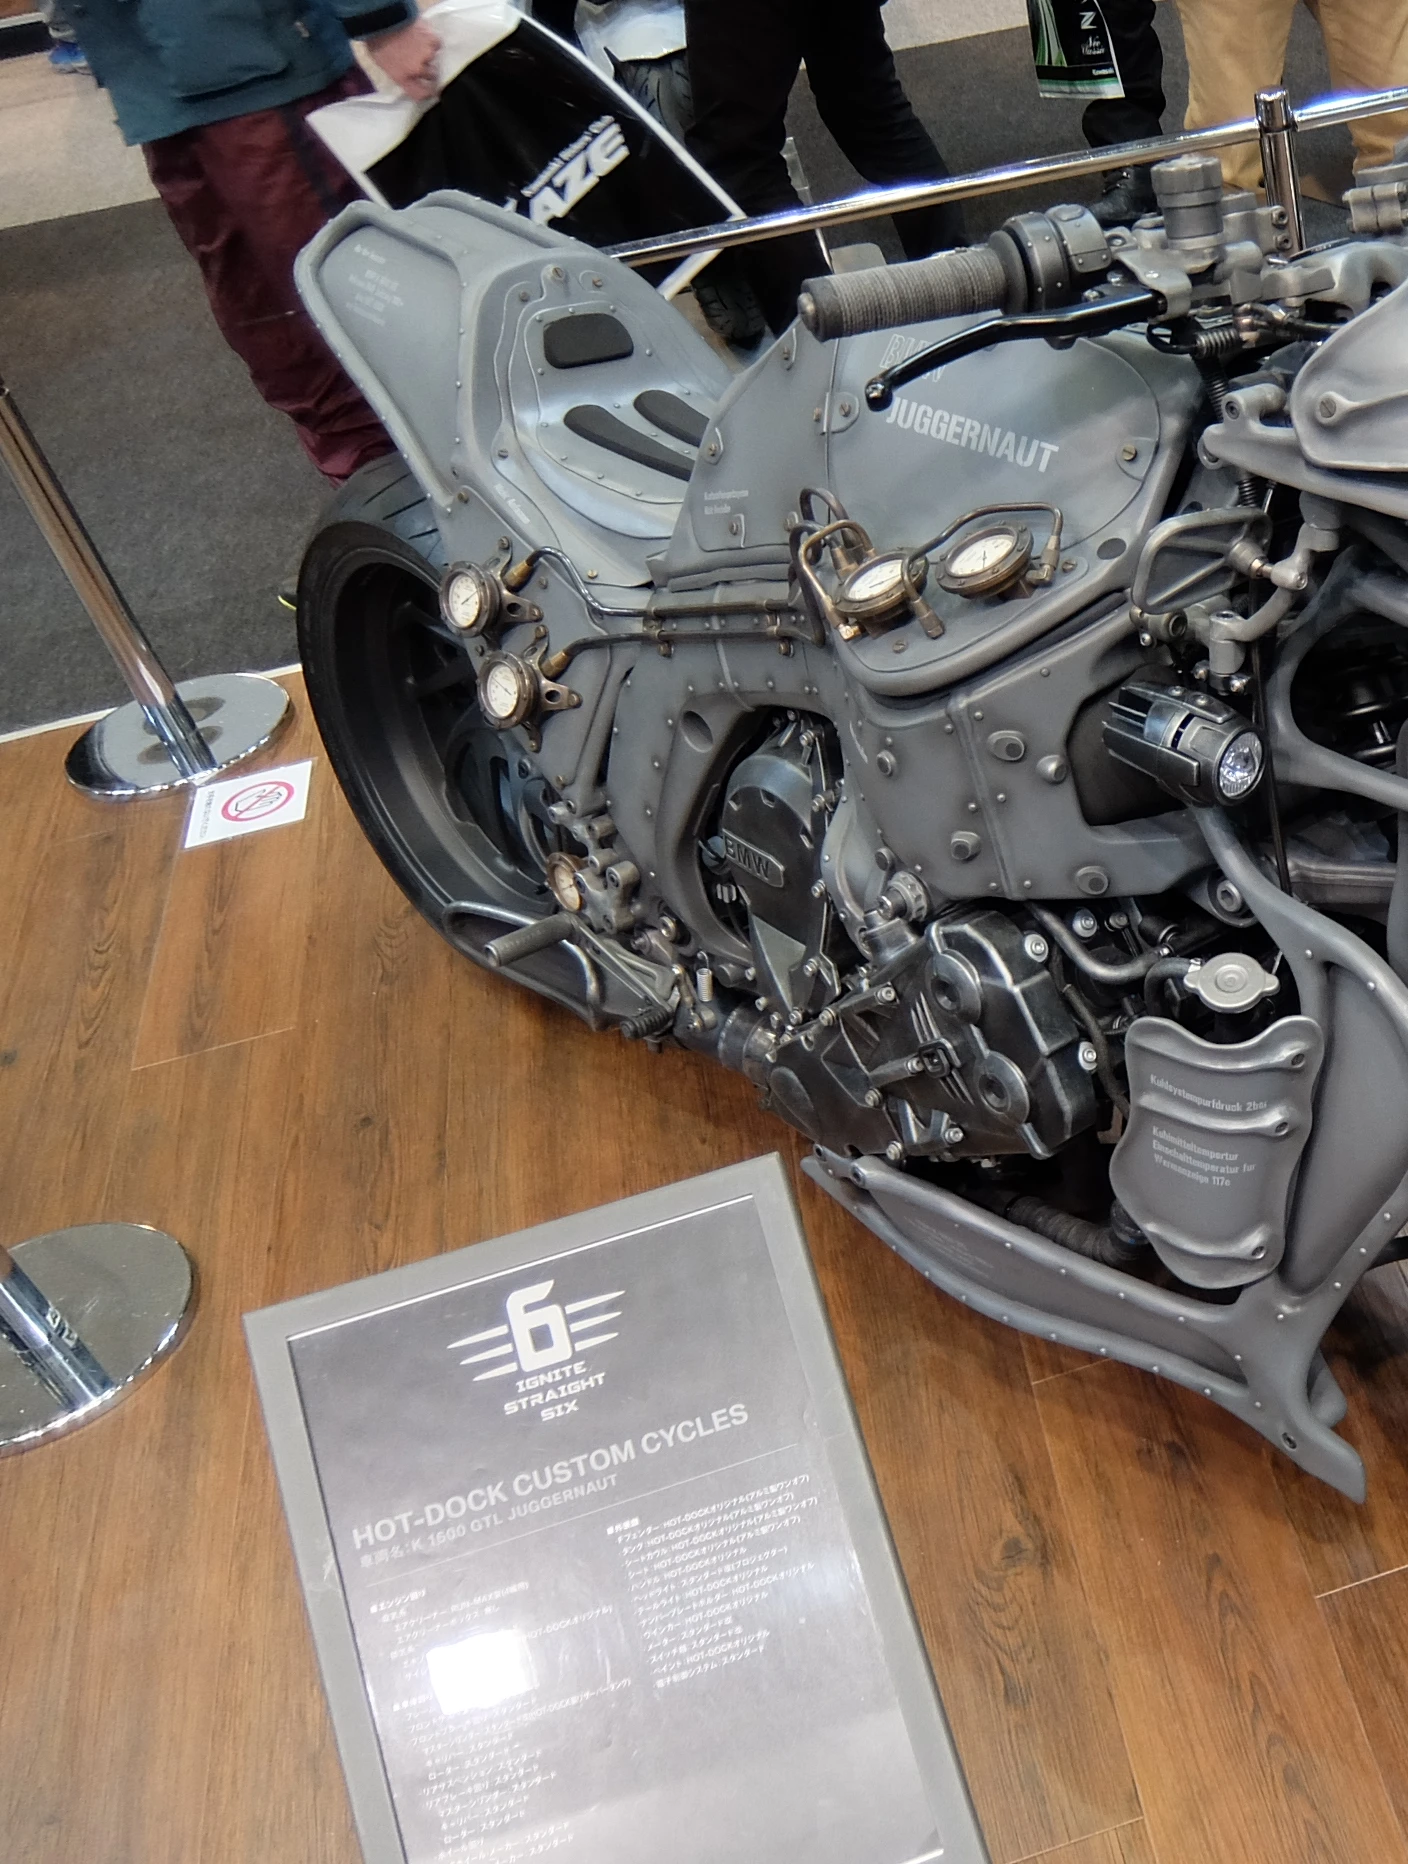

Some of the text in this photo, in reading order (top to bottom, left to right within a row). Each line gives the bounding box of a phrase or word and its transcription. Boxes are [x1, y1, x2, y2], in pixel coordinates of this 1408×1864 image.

[529, 122, 631, 227] AZE
[885, 397, 1060, 473] JUGGERNAUT
[503, 1372, 606, 1415] STRAIGHT
[515, 1360, 588, 1393] IGNITE
[540, 1399, 580, 1422] SIX
[352, 1402, 750, 1550] HOT-DOCK CUSTOM CYCLES
[427, 1523, 468, 1548] 1600
[470, 1513, 504, 1534] GTL
[507, 1474, 620, 1522] JUGGERNAUT
